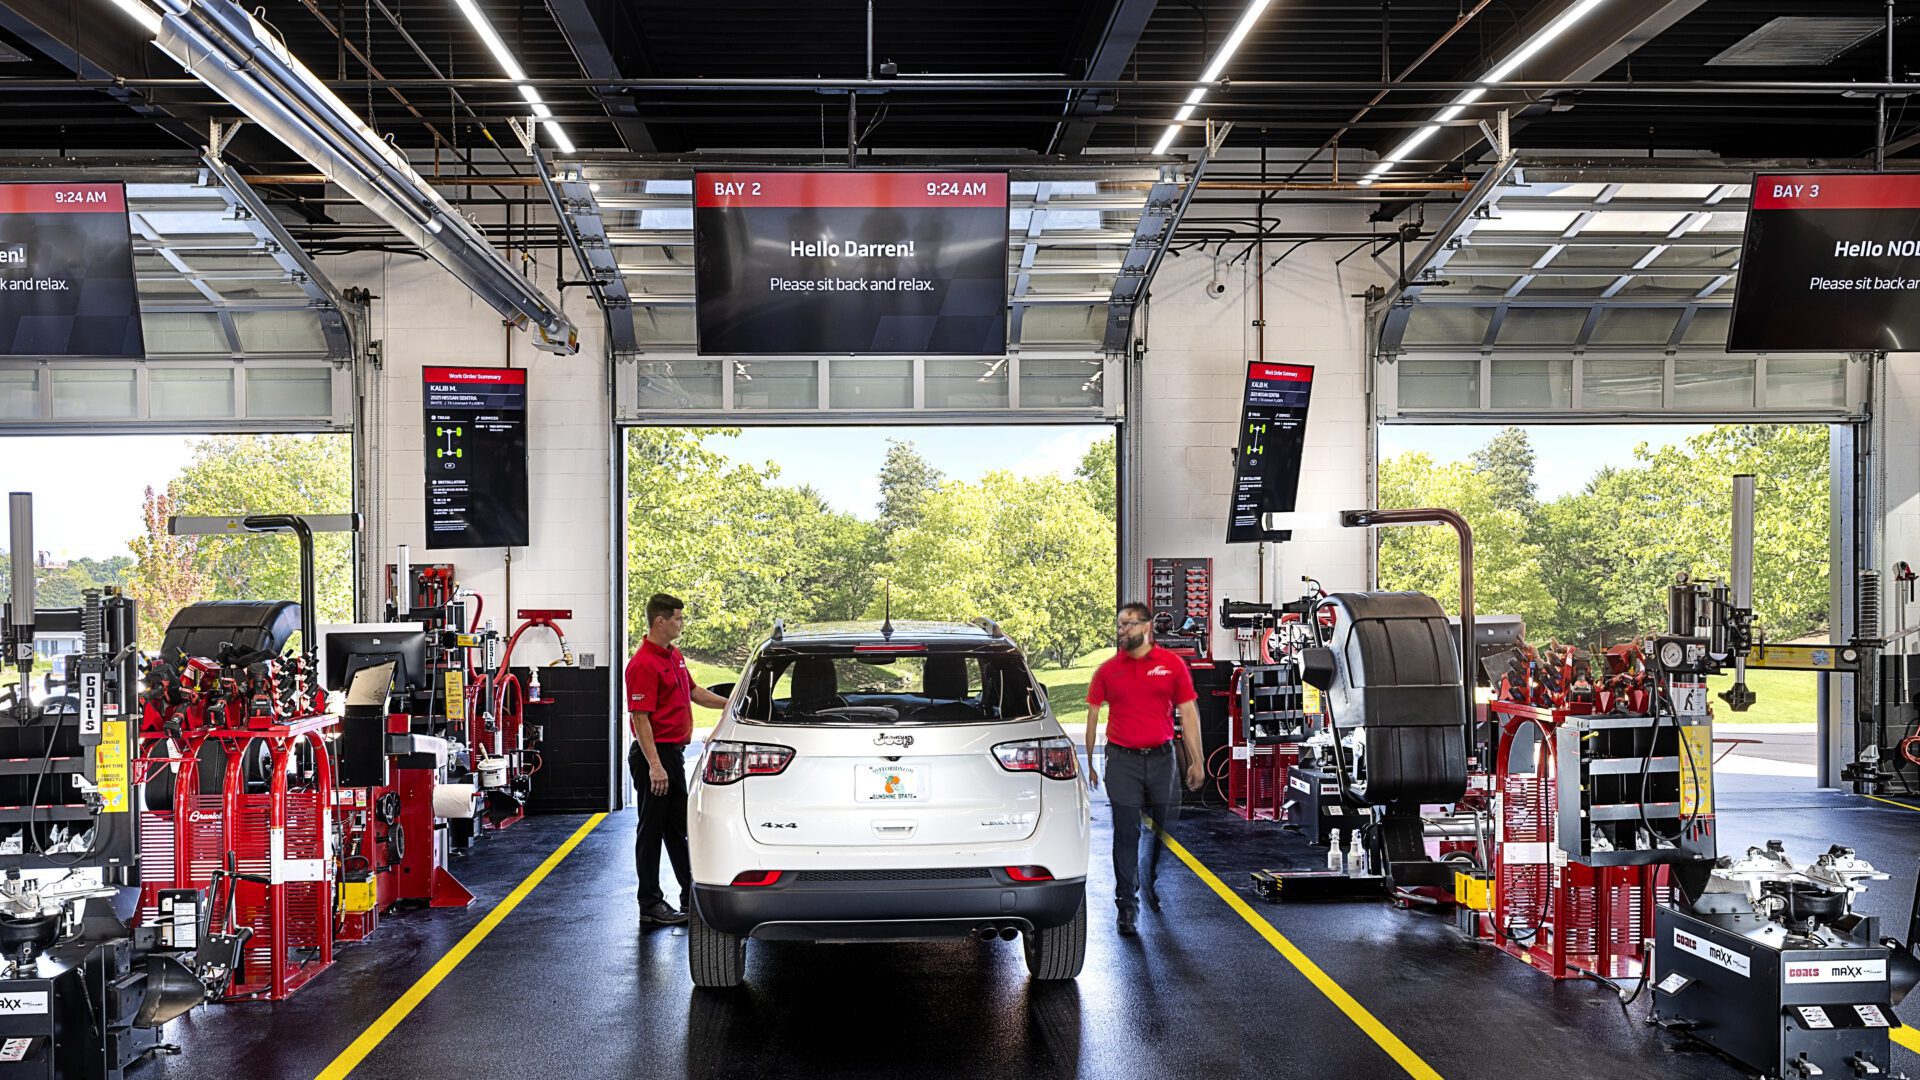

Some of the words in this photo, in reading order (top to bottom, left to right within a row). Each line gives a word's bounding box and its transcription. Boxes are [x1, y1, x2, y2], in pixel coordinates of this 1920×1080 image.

[714, 182, 745, 196] BAY
[751, 182, 762, 196] 2
[926, 182, 960, 196] 9:24
[962, 182, 987, 196] AM
[1773, 184, 1804, 198] BAY
[1809, 184, 1820, 198] 3
[55, 191, 83, 203] 9:24
[86, 191, 107, 203] AM
[790, 241, 841, 258] Hello
[845, 241, 915, 258] Darren!
[1834, 241, 1884, 257] Hello
[9, 278, 34, 290] and
[35, 278, 69, 290] relax.
[770, 278, 815, 291] Please
[817, 278, 835, 291] sit
[836, 278, 869, 291] back
[870, 278, 898, 291] and
[899, 278, 935, 291] relax.
[1810, 278, 1854, 290] Please
[1855, 277, 1873, 290] sit
[1874, 277, 1905, 290] back
[85, 675, 96, 731] COATS
[873, 733, 914, 748] Jeep
